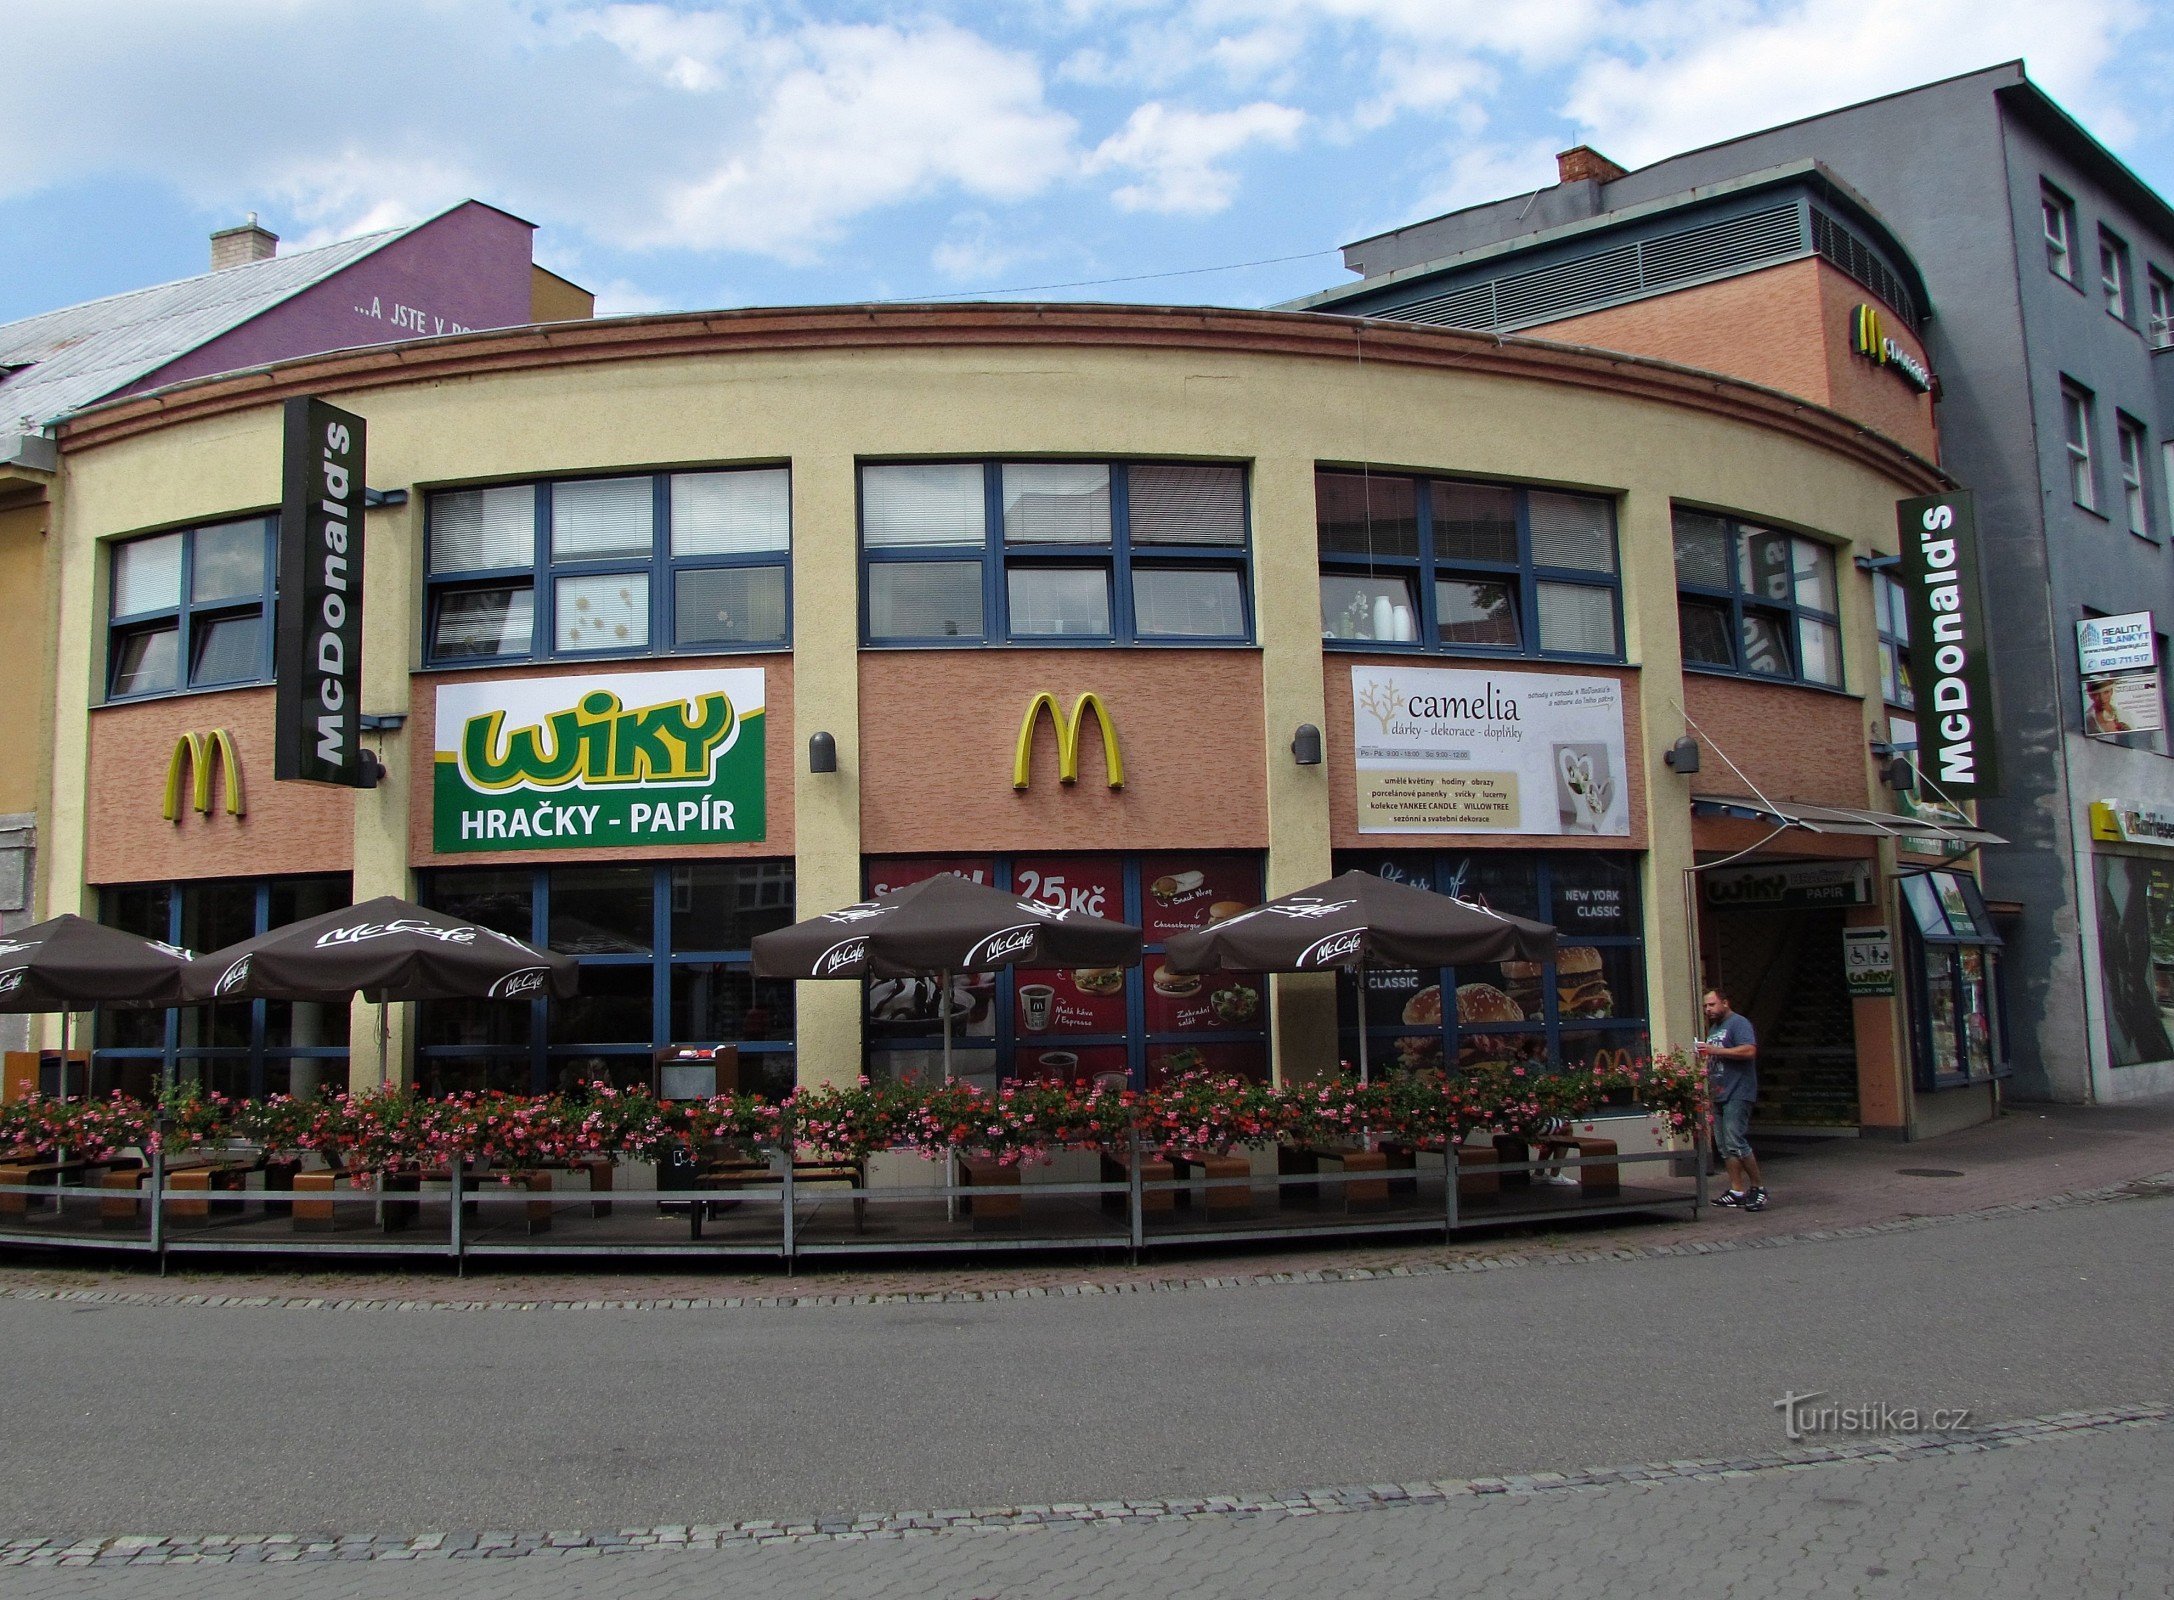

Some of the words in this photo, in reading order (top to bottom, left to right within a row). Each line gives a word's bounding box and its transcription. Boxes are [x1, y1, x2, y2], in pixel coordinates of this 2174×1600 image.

[391, 304, 426, 333] JSTE
[435, 317, 444, 335] V
[317, 421, 350, 767] McDonald's
[2102, 624, 2142, 636] REALITY
[2103, 632, 2150, 645] BLANKYT
[1920, 504, 1975, 783] McDonald's
[2100, 658, 2116, 666] 603
[2134, 654, 2149, 662] 517
[1408, 681, 1521, 721] camelia
[1391, 721, 1422, 739] dárky
[1431, 723, 1475, 737] dekorace
[1484, 724, 1523, 742] doplňky
[1384, 777, 1407, 785] umělé
[1408, 777, 1435, 787] květiny
[1441, 778, 1466, 787] hodiny
[1471, 778, 1495, 787] obrazy
[1371, 789, 1416, 799] porcelánové
[1417, 790, 1448, 799] panenky
[1455, 790, 1476, 799] svíčky
[1483, 790, 1507, 800] lucerny
[1370, 802, 1398, 810] kolekce
[1400, 802, 1427, 810] YANKEE
[1428, 802, 1457, 810] CANDLE
[461, 801, 600, 840] HRAČKY
[631, 794, 735, 834] PAPÍR
[1393, 814, 1421, 823] sezónní
[1427, 815, 1458, 823] svatební
[1459, 815, 1490, 823] dekorace
[1018, 870, 1067, 911] 25
[1173, 894, 1196, 906] Snack
[1195, 888, 1213, 901] Wrap
[1566, 890, 1590, 901] NEW
[1592, 889, 1620, 901] YORK
[1577, 906, 1620, 917] CLASSIC
[315, 919, 478, 948] McCafé
[987, 927, 1035, 962] McCafé
[1316, 933, 1362, 965] McCafé
[828, 942, 865, 973] McCafé
[505, 973, 545, 997] McCafé
[1369, 977, 1419, 989] CLASSIC
